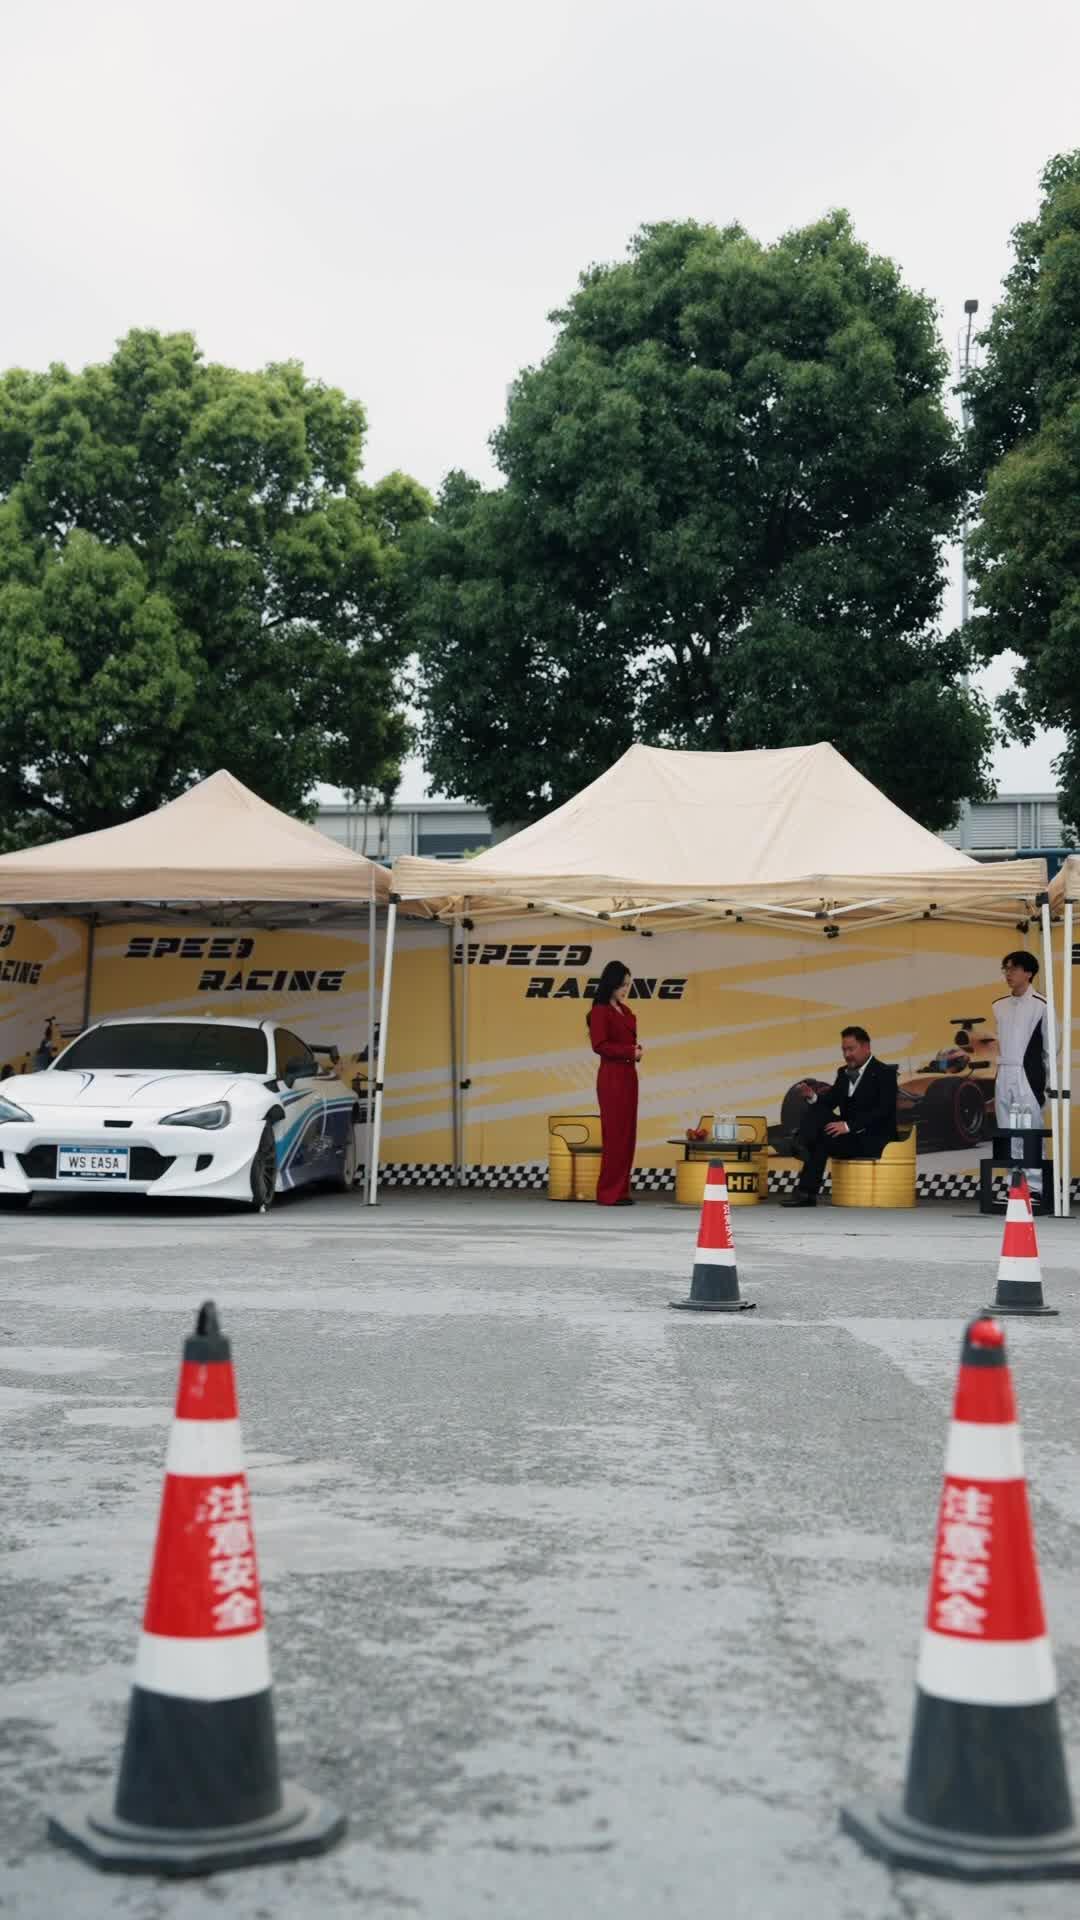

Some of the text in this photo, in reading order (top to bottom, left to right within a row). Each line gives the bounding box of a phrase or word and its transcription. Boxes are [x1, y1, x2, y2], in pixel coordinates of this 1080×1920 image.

[124, 937, 255, 958] SPEED
[453, 943, 593, 966] SPEED
[0, 959, 43, 985] CING
[198, 970, 347, 991] RACING
[525, 977, 688, 1000] RACNG
[69, 1156, 86, 1168] WS
[937, 1484, 993, 1635] 注意安全
